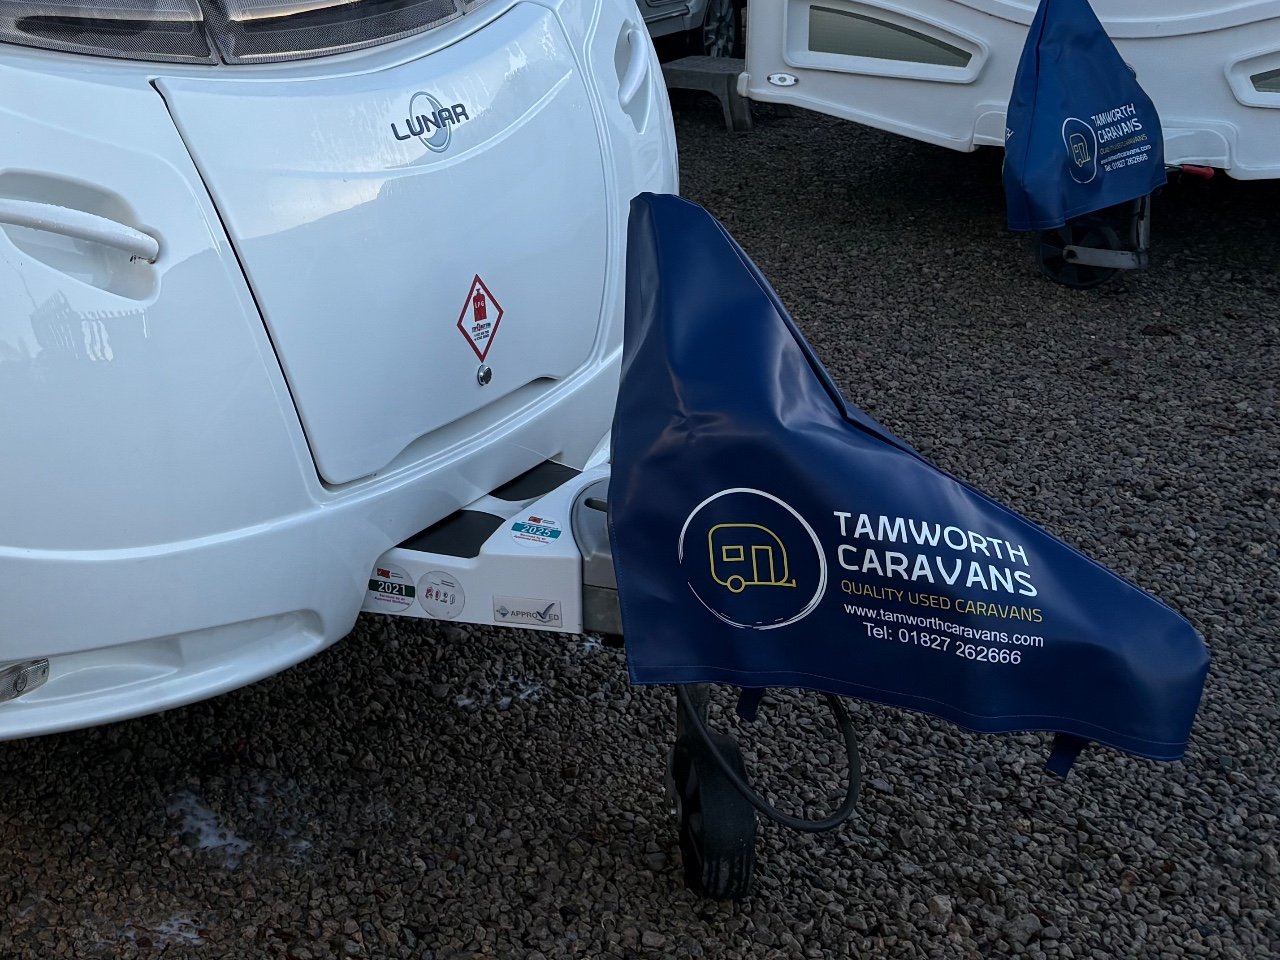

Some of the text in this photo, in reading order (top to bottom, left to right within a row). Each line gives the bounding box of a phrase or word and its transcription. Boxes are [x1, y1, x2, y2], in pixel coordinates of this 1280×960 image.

[391, 103, 469, 140] LUNAR
[1091, 103, 1136, 127] TAMWORTH
[1098, 118, 1142, 143] CARAVANS
[474, 300, 485, 309] LPG
[521, 525, 551, 537] 2025
[834, 511, 1029, 566] TAMWORTH
[837, 544, 1037, 597] CARAVANS
[378, 581, 406, 596] 2021
[841, 580, 1043, 623] QUALITY USED CARAVANS
[511, 606, 559, 621] APPROVED
[844, 604, 1044, 647] www.tamworthcaravans.com
[863, 622, 1021, 664] Tel: 01827 262666
